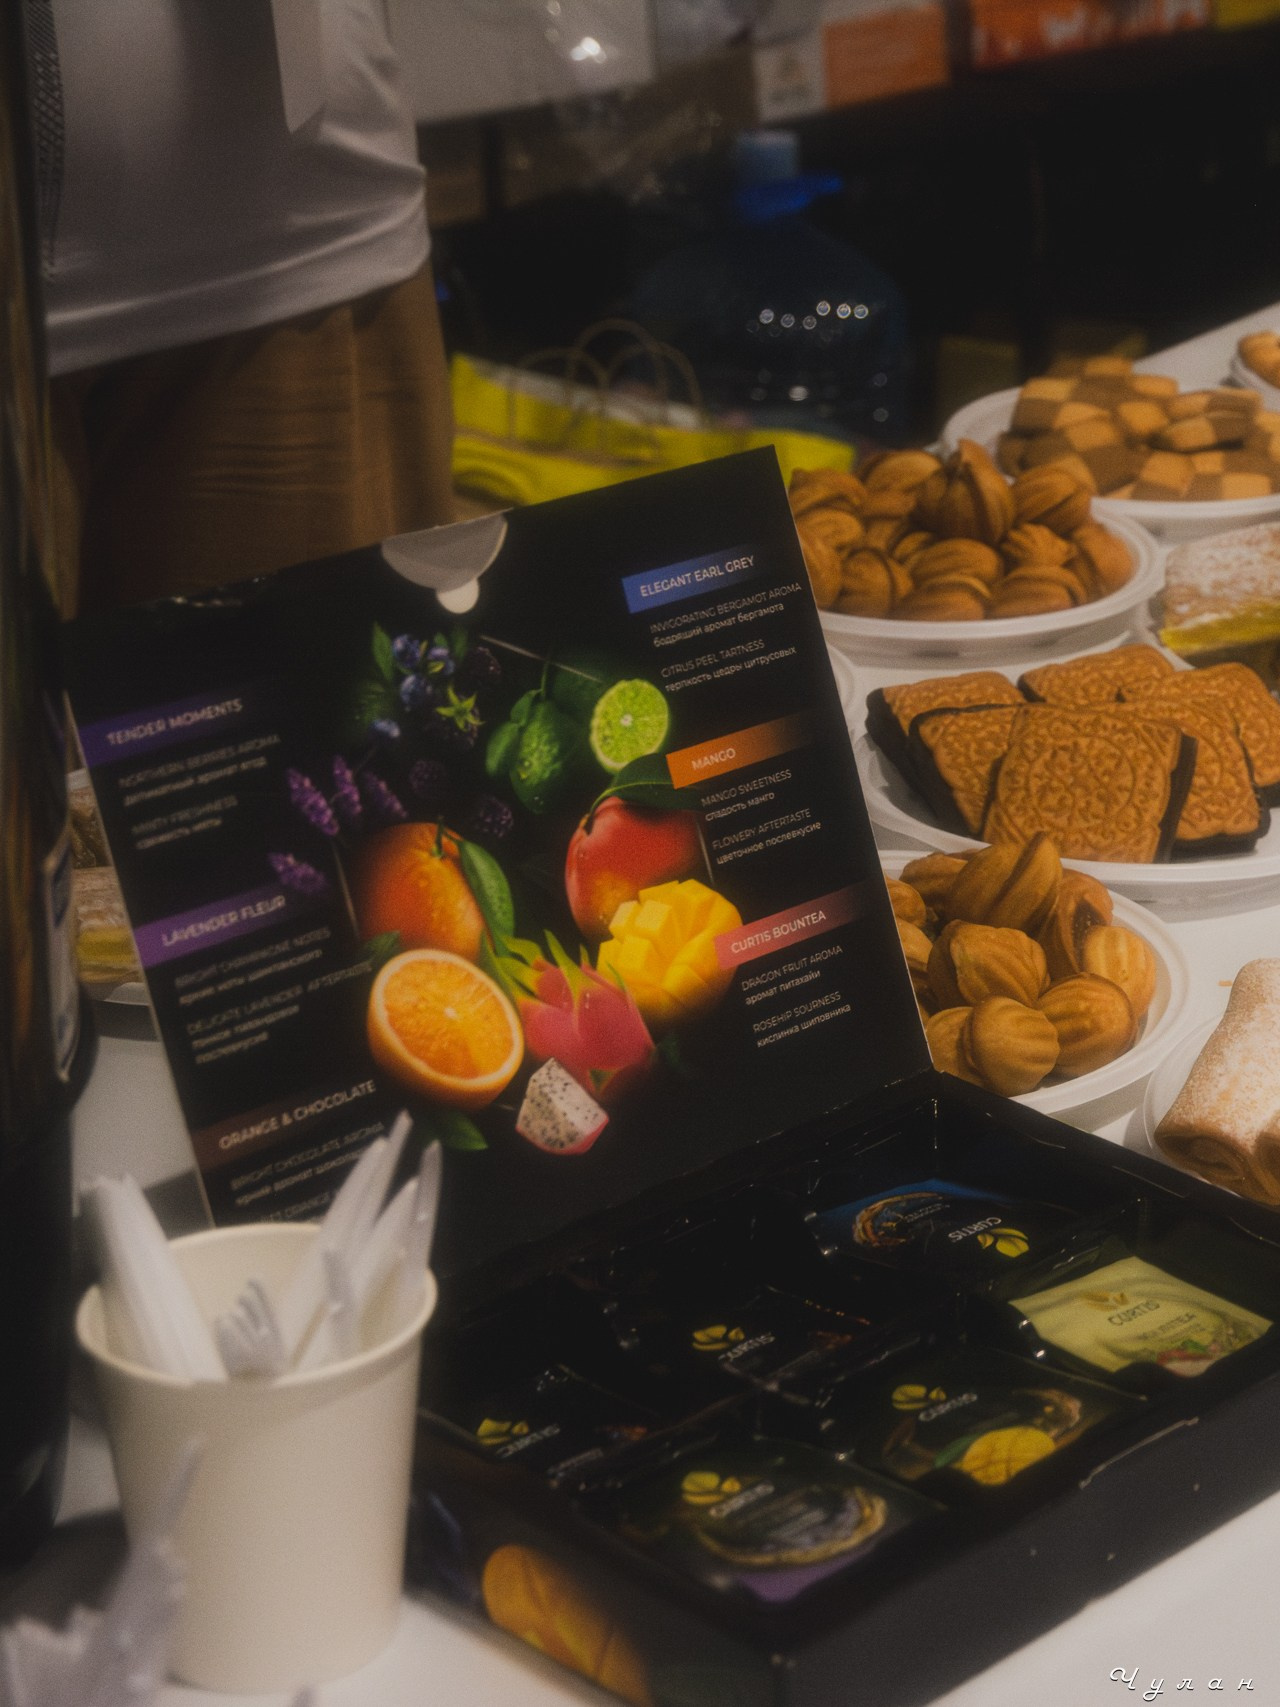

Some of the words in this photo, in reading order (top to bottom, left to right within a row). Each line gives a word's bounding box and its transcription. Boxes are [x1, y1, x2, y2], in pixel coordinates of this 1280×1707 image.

[640, 573, 691, 597] ELEGANT
[694, 566, 724, 581] EARL
[725, 555, 754, 572] GREY
[650, 608, 716, 634] INVIGORATING
[717, 592, 767, 617] BERGAMOT
[768, 583, 802, 600] AROMA
[653, 625, 702, 649] бодрящий
[704, 617, 736, 634] аромат
[737, 603, 784, 625] бергамота
[661, 659, 695, 679] CITRUS
[696, 651, 718, 667] PEEL
[720, 640, 765, 662] TARTNESS
[665, 672, 712, 693] терпкость
[713, 662, 743, 681] цедры
[744, 646, 796, 671] цитрусовых
[106, 719, 166, 744] TENDER
[168, 698, 244, 728] MOMENTS
[691, 747, 736, 771] MANGO
[700, 786, 738, 808] MANGO
[739, 769, 792, 795] SWEETNESS
[705, 802, 747, 822] сладость
[748, 791, 775, 808] манго
[712, 827, 757, 851] FLOWERY
[758, 808, 812, 835] AFTERTASTE
[716, 842, 764, 866] цветочное
[765, 821, 823, 848] послевкусие
[162, 911, 238, 947] LAVENDER
[240, 895, 286, 920] FLEUR
[730, 931, 771, 954] CURTIS
[772, 910, 827, 938] BOUNTEA
[742, 968, 782, 992] DRAGON
[782, 957, 808, 977] FRUIT
[810, 944, 844, 966] AROMA
[745, 986, 778, 1006] аромат
[778, 969, 821, 992] питахайи
[752, 1011, 793, 1034] ROSEHIP
[794, 991, 841, 1018] SOURNESS
[757, 1024, 800, 1048] кислинка
[801, 1003, 852, 1030] шиповника
[218, 1117, 280, 1150] ORANGE
[281, 1112, 293, 1127] &
[293, 1079, 377, 1121] CHOCOLATE
[947, 1216, 1002, 1243] CURTIS
[1107, 1299, 1160, 1326] CURTIS
